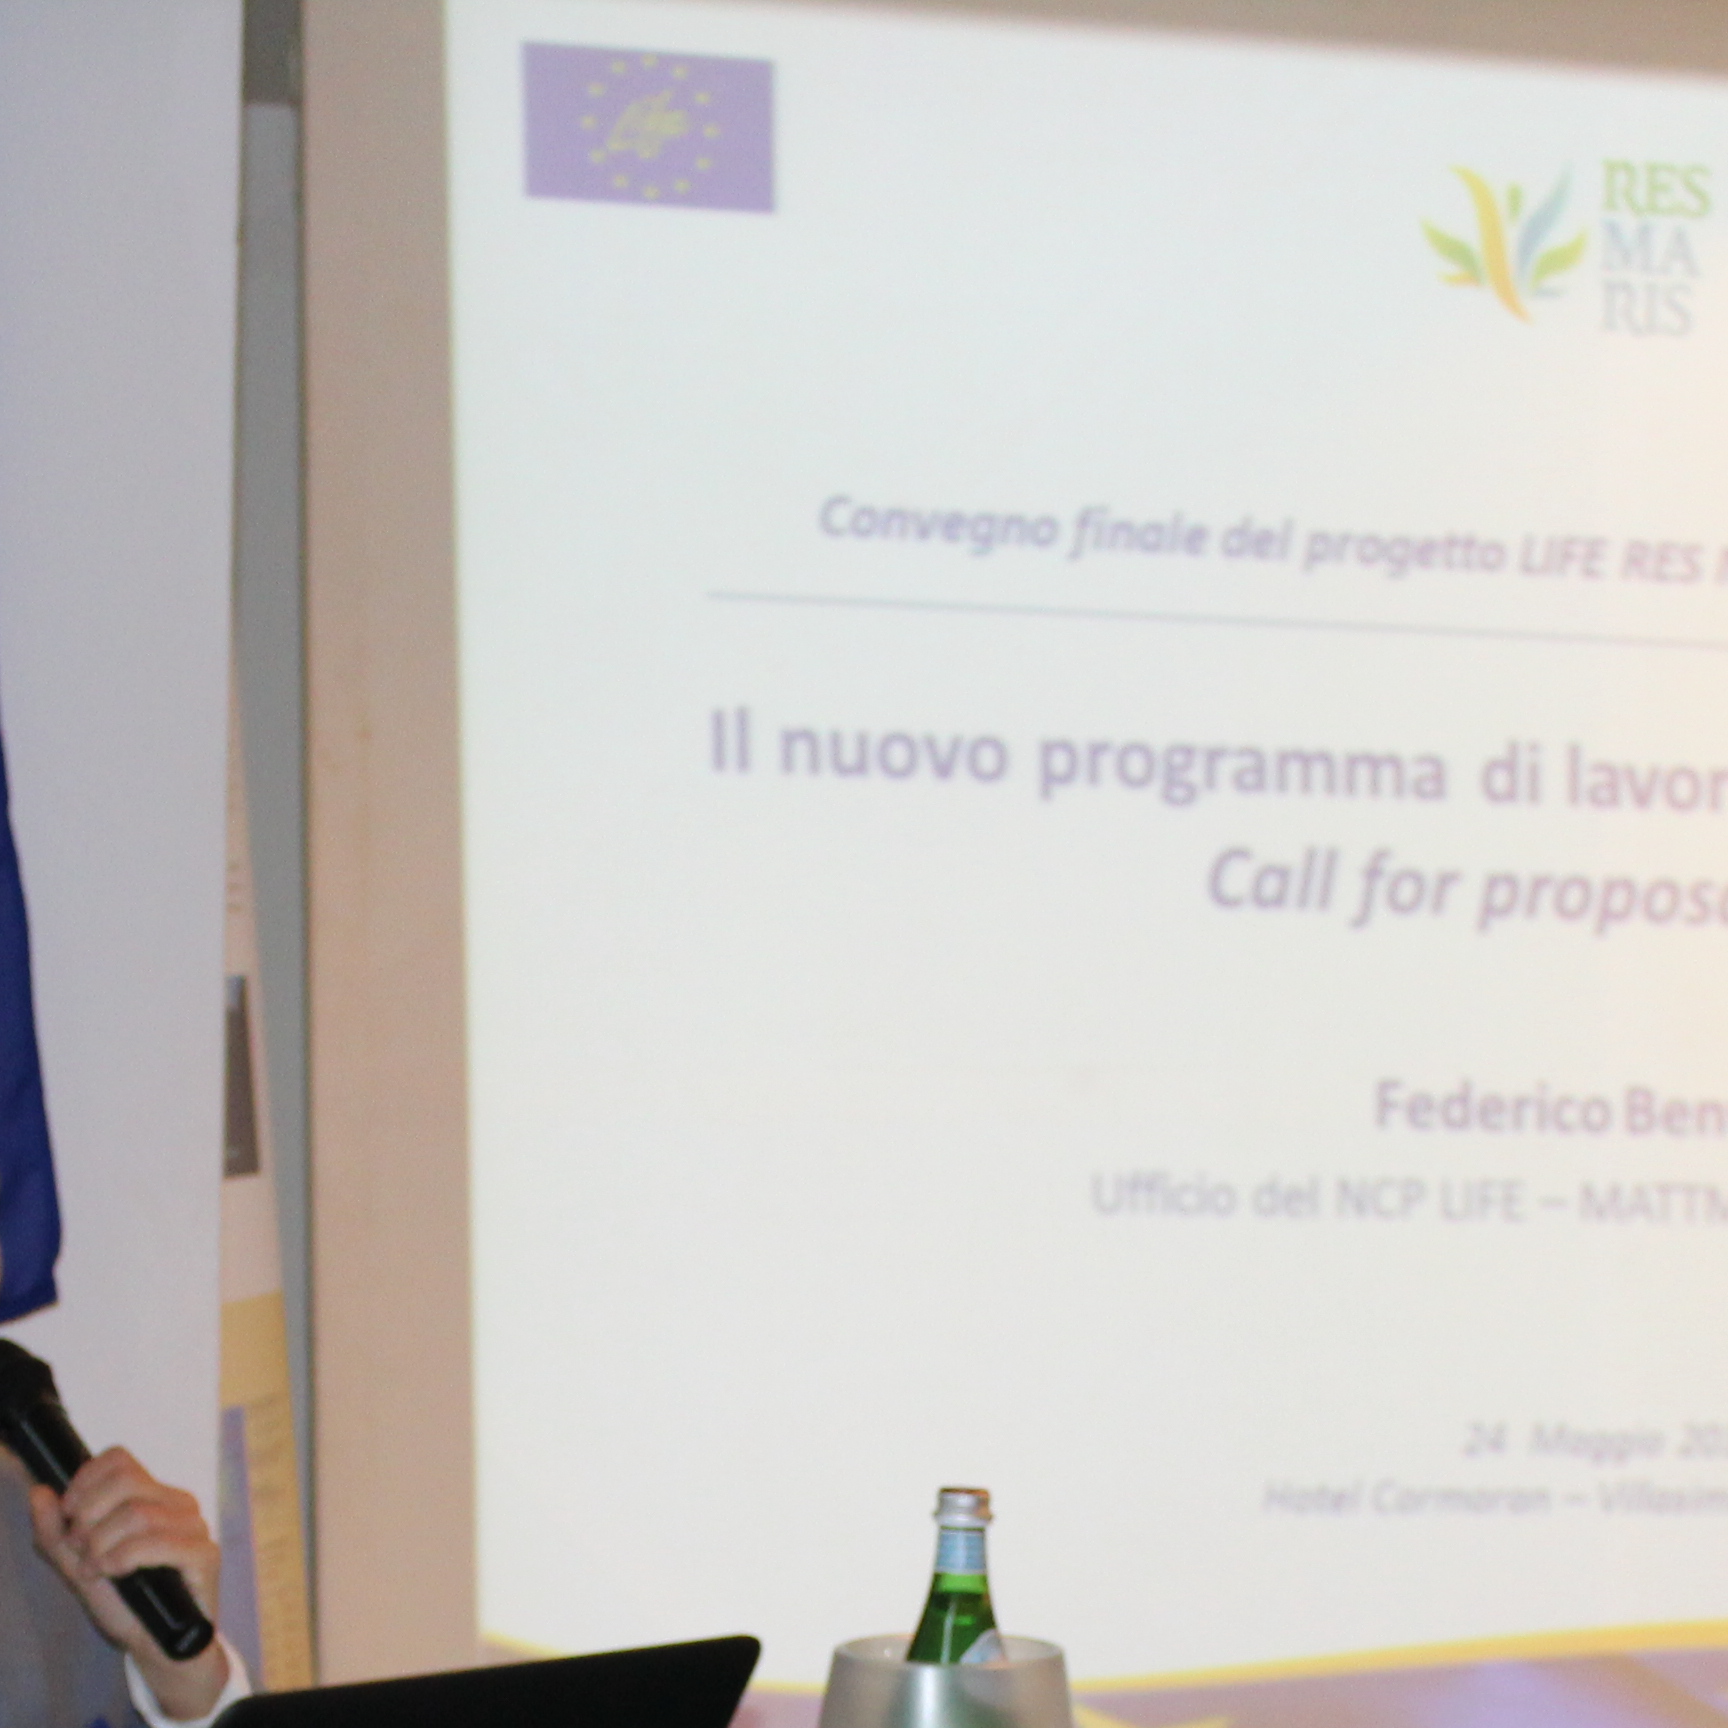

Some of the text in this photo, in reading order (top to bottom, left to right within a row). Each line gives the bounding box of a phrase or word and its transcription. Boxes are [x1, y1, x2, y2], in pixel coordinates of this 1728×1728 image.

[1602, 158, 1713, 219] RES
[818, 493, 1061, 558] Convegno
[1067, 505, 1211, 561] finale
[1220, 516, 1294, 561] del
[1302, 529, 1507, 580] progetto
[1518, 534, 1608, 580] LIFE
[1621, 539, 1703, 584] RES
[711, 705, 752, 774] Il
[779, 726, 1011, 784] nuovo
[1038, 737, 1448, 808] programma
[1479, 739, 1542, 805] di
[1207, 845, 1339, 911] Call
[1349, 850, 1460, 929] for
[1374, 1077, 1613, 1135] Federico
